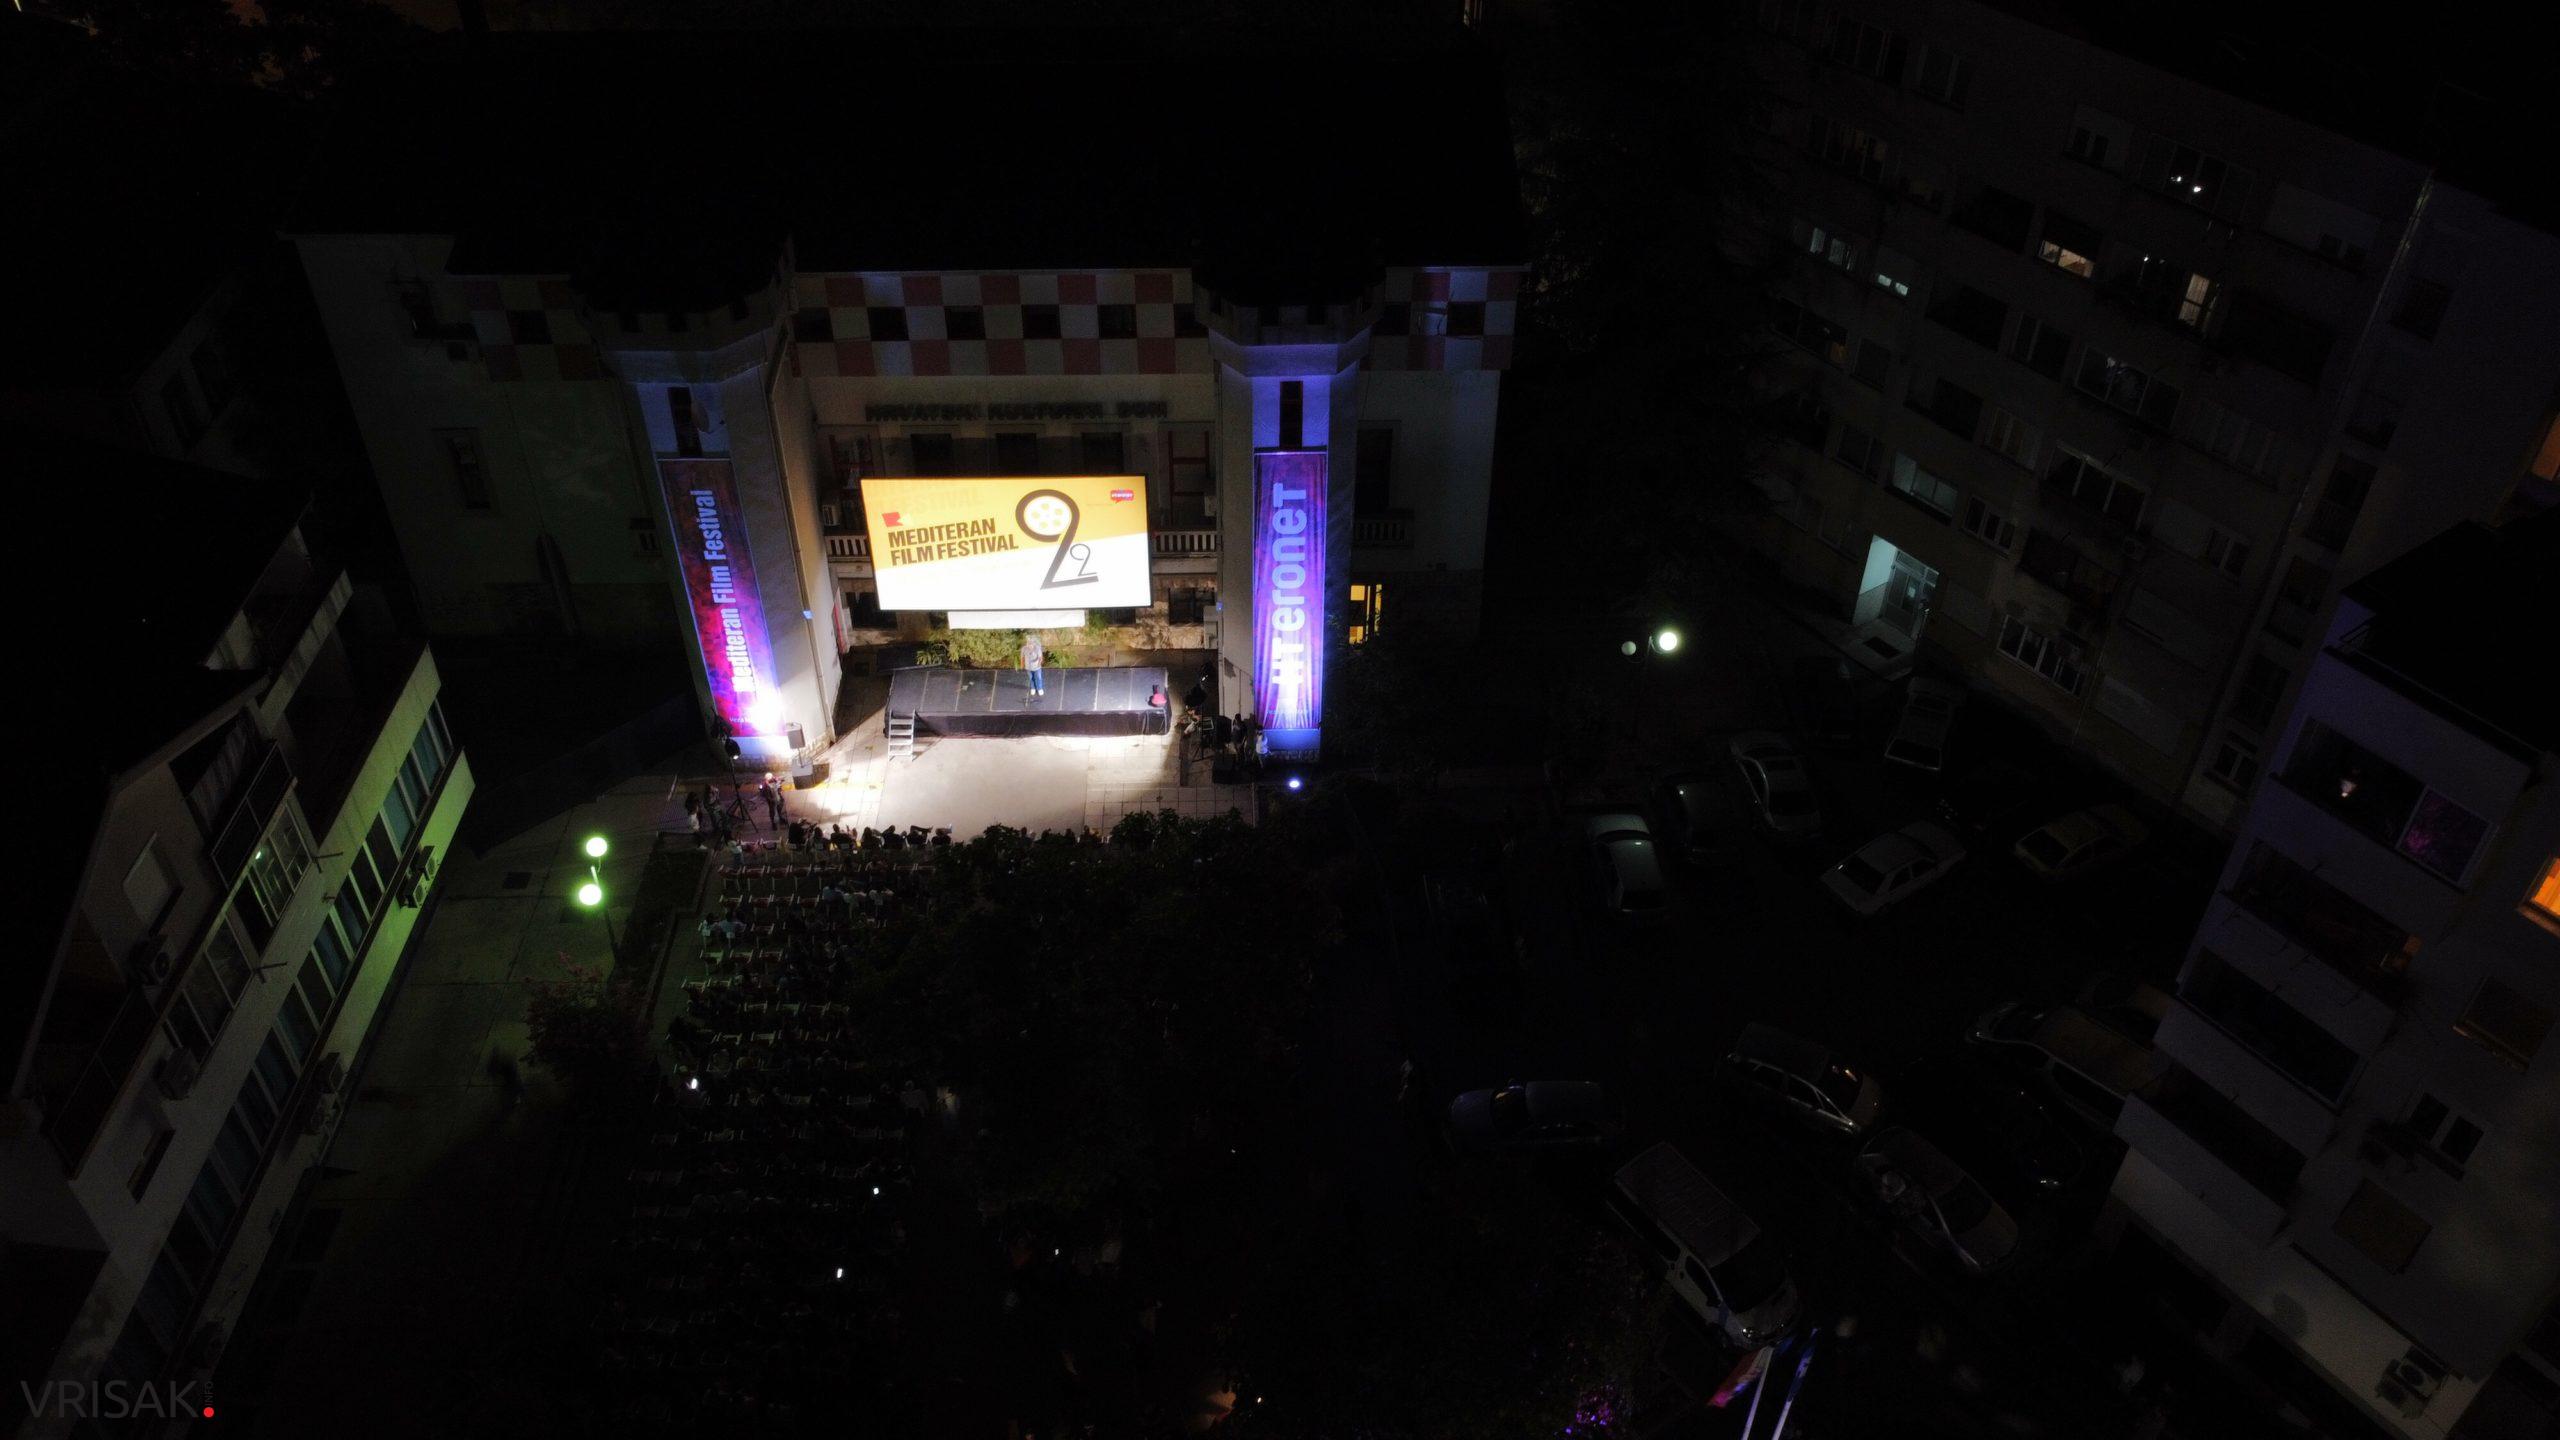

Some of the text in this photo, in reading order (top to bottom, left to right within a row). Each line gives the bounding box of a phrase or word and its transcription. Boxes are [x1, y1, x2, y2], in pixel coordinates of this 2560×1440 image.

[690, 489, 727, 560] Festival
[887, 518, 996, 548] MEDITERAN
[890, 534, 1020, 567] FILM FESTIVAL
[710, 565, 737, 604] Film
